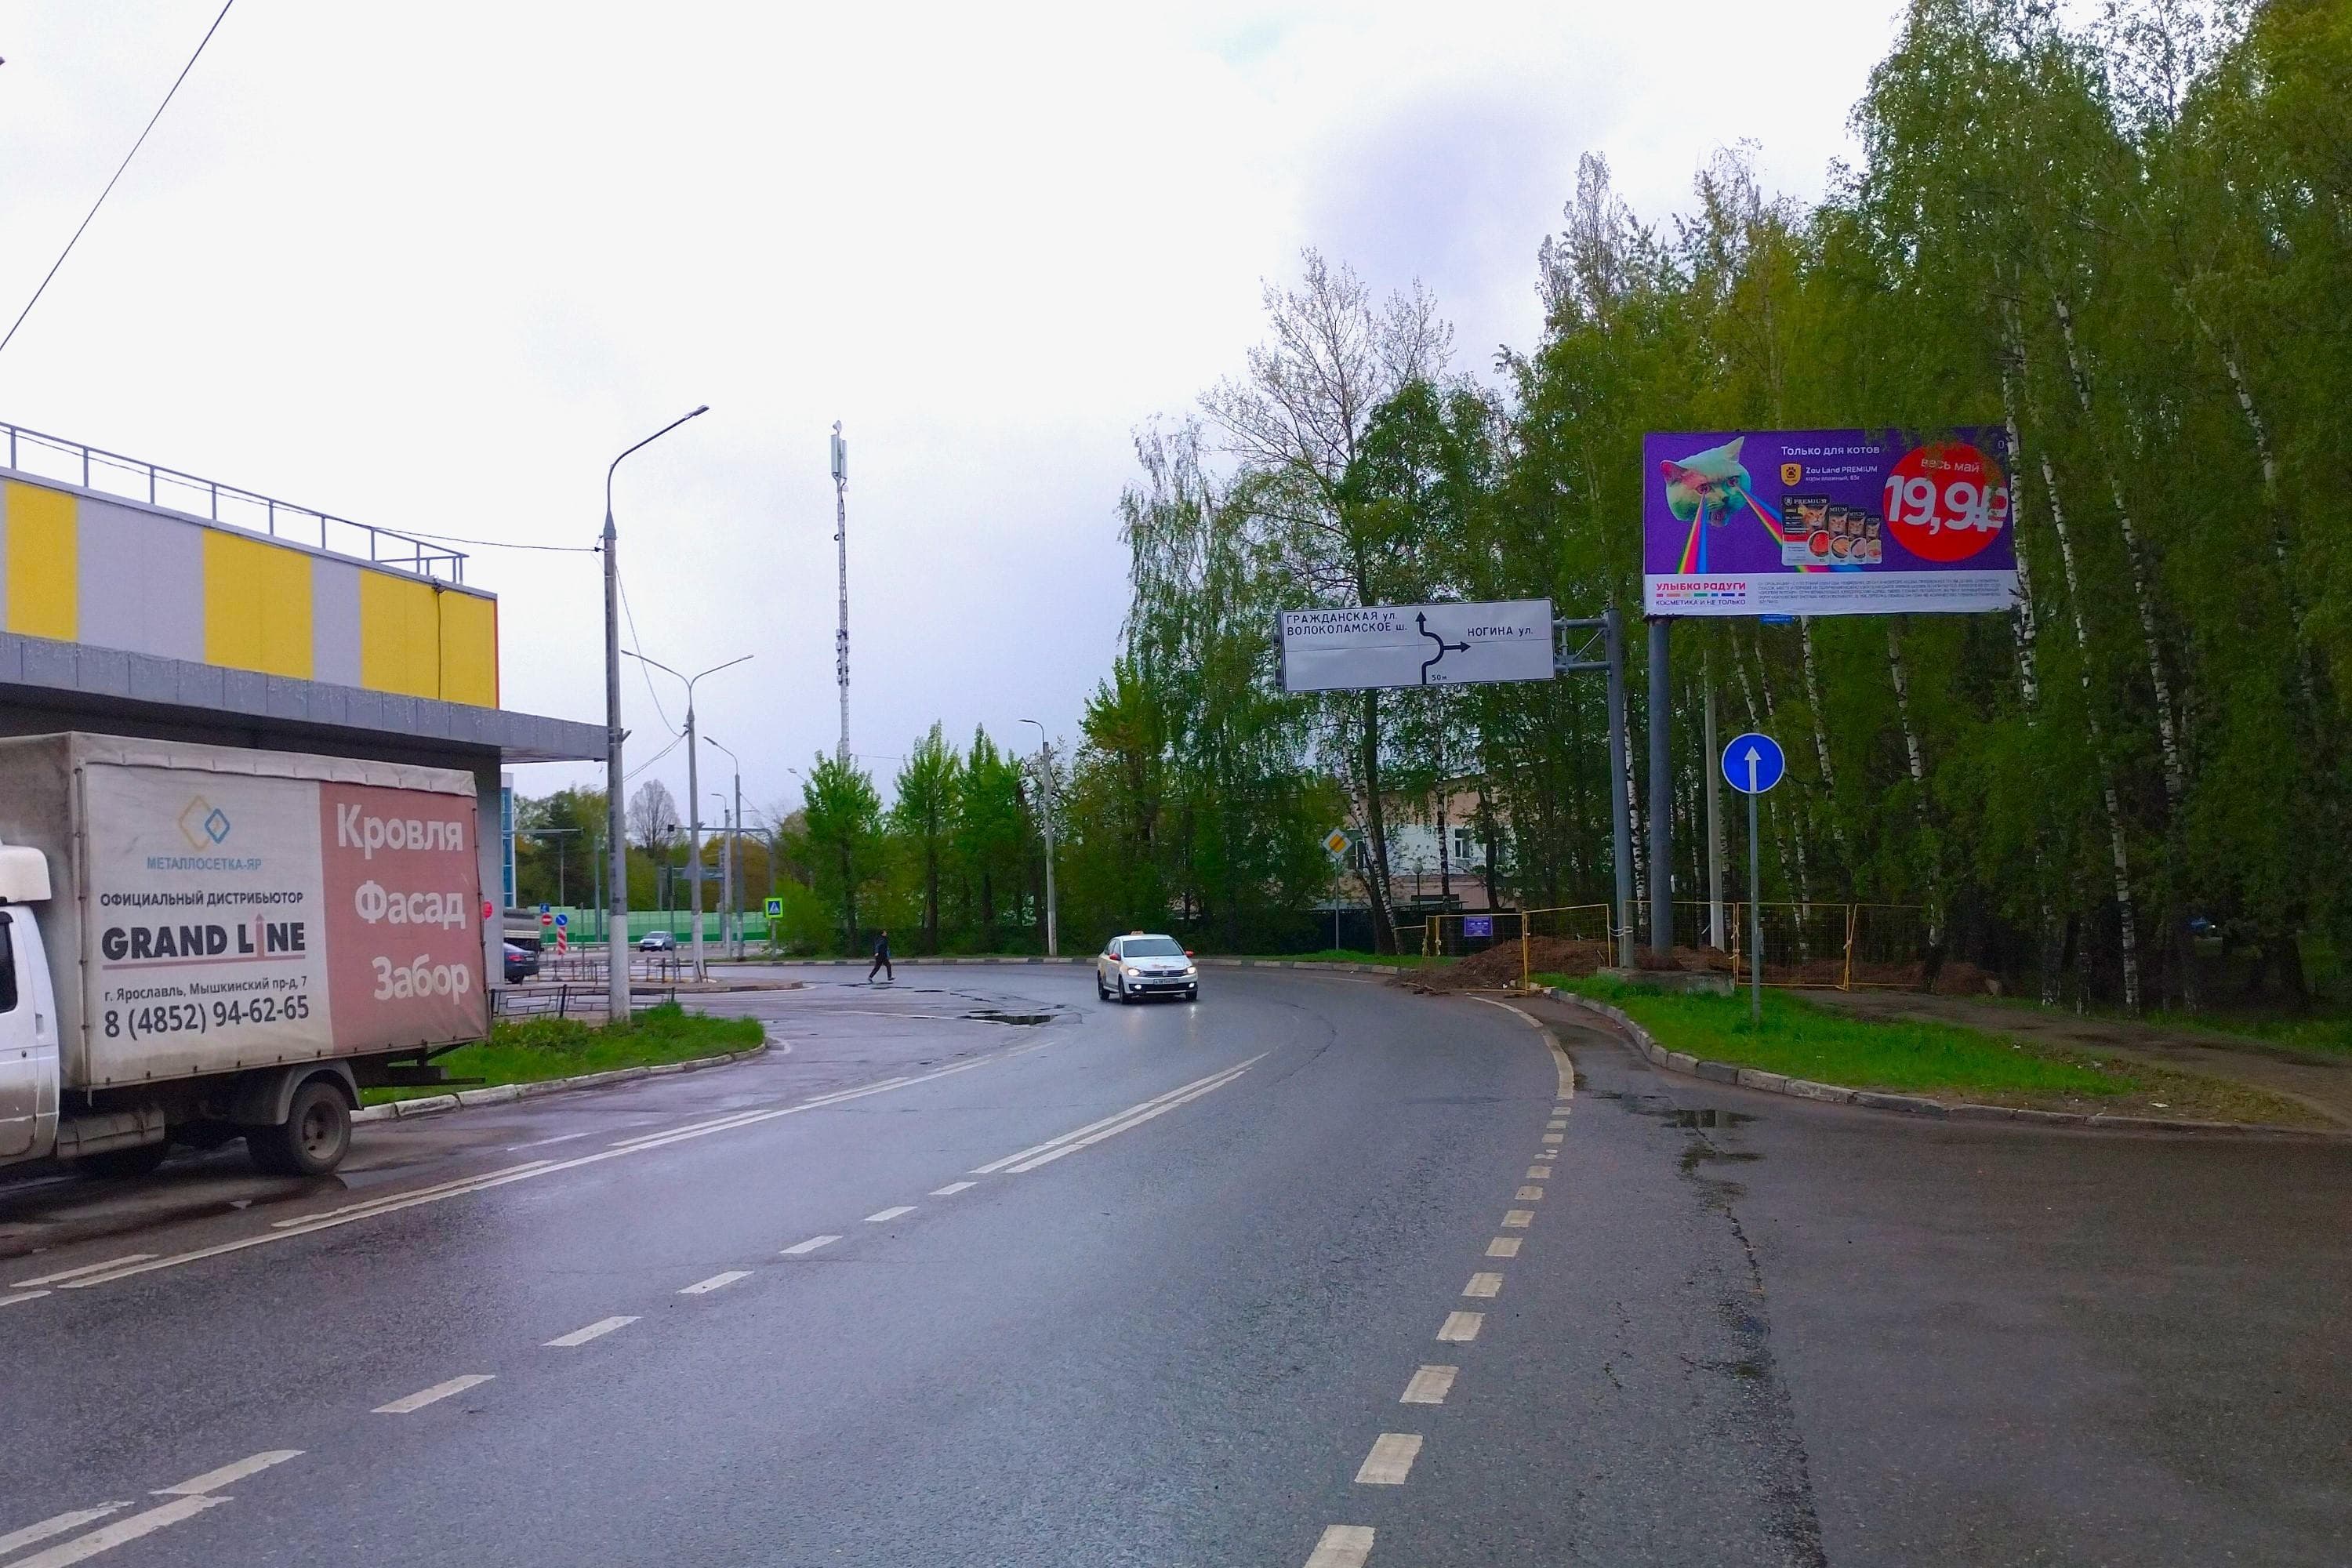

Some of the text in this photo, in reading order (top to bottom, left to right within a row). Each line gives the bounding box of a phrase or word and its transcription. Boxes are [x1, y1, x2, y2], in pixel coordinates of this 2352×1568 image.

[1780, 446, 1880, 456] Только для котов
[1955, 462, 1980, 474] май
[1287, 611, 1378, 624] ГРАЖДАНСКАЯ
[1287, 622, 1392, 636] ВОЛОКОЛАМСКОЕ
[1467, 626, 1534, 637] НОГИНА ул.
[336, 803, 463, 860] Кровля
[147, 856, 262, 870] МЕТАЛЛОСЕТКА-ЯР
[100, 890, 304, 908] ОФИЦИАЛЬНЫЙ ДИСТРИБЬЮТОР
[354, 880, 466, 930] Фасад
[101, 915, 306, 960] GRAND LINE
[371, 953, 470, 1005] Забор
[104, 975, 307, 1004] г. Ярославль, Мышкинский пр-д, 7
[104, 994, 310, 1041] 8 (4852) 94-62-65
